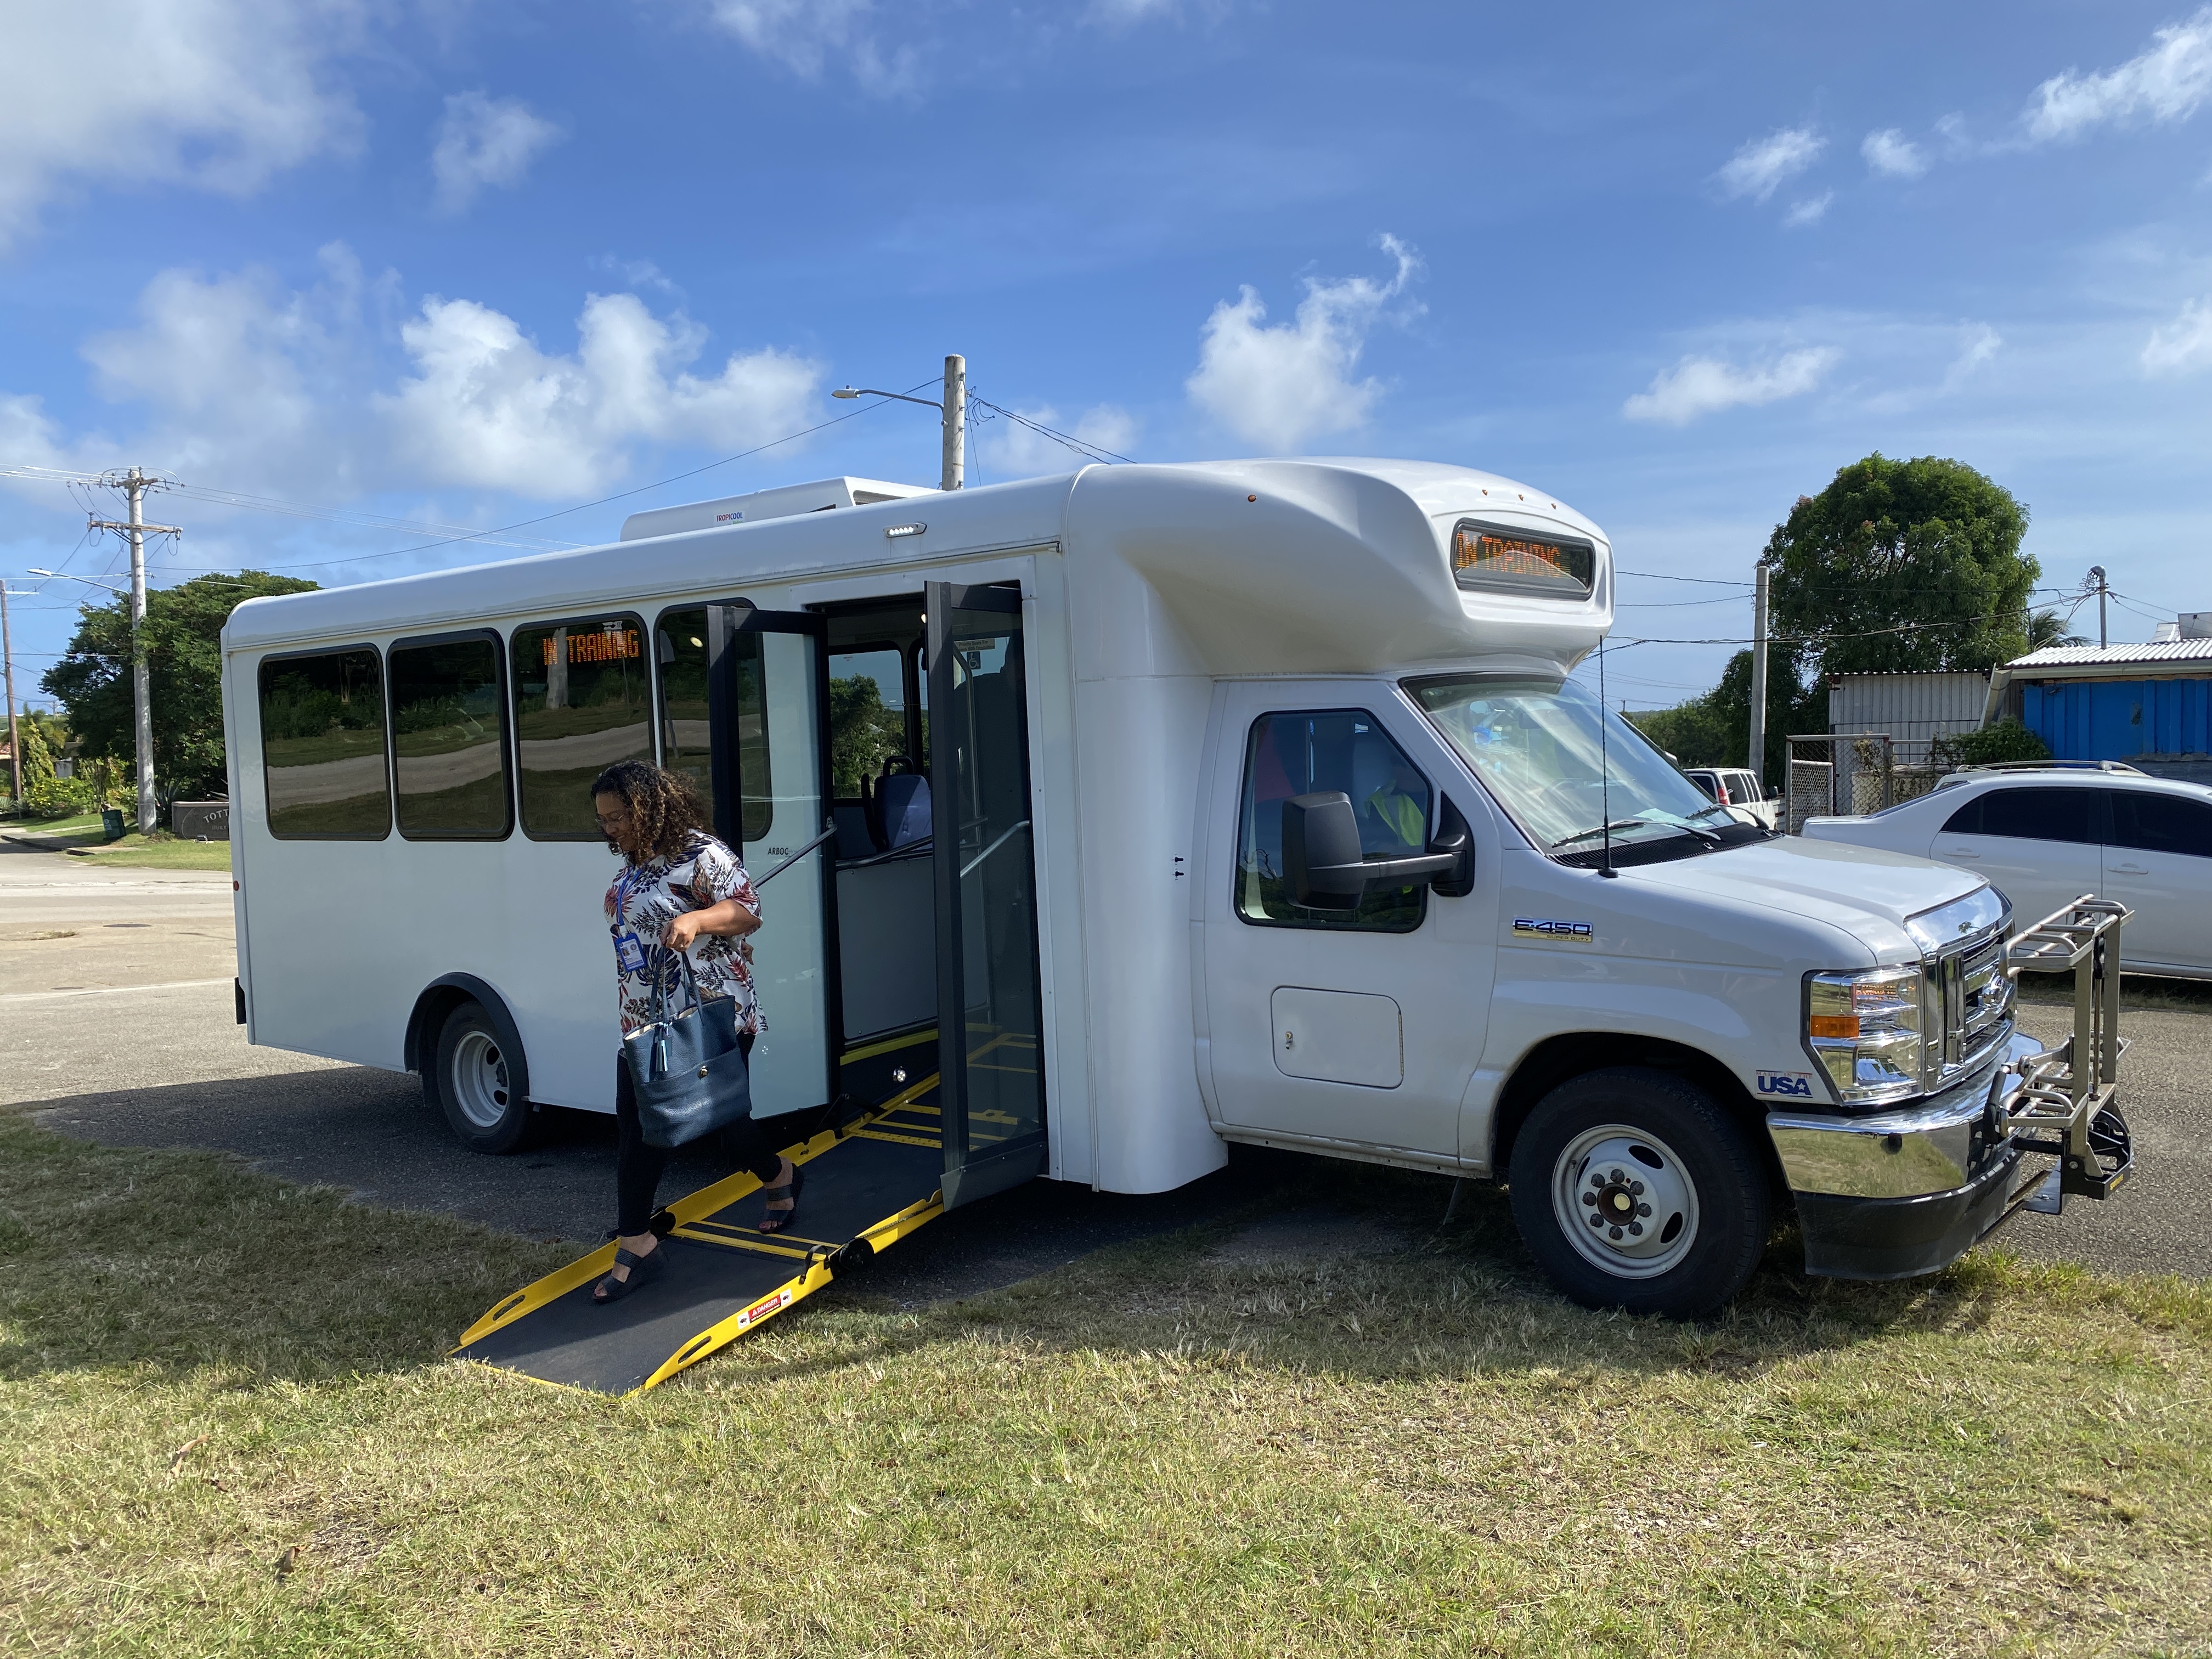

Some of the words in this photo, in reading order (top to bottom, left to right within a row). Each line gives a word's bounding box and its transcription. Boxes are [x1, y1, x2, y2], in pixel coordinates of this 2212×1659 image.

[716, 512, 743, 522] TROPICOOL
[566, 630, 639, 663] TRAINING
[1758, 1076, 1812, 1096] USA
[757, 1297, 778, 1313] DANGER
